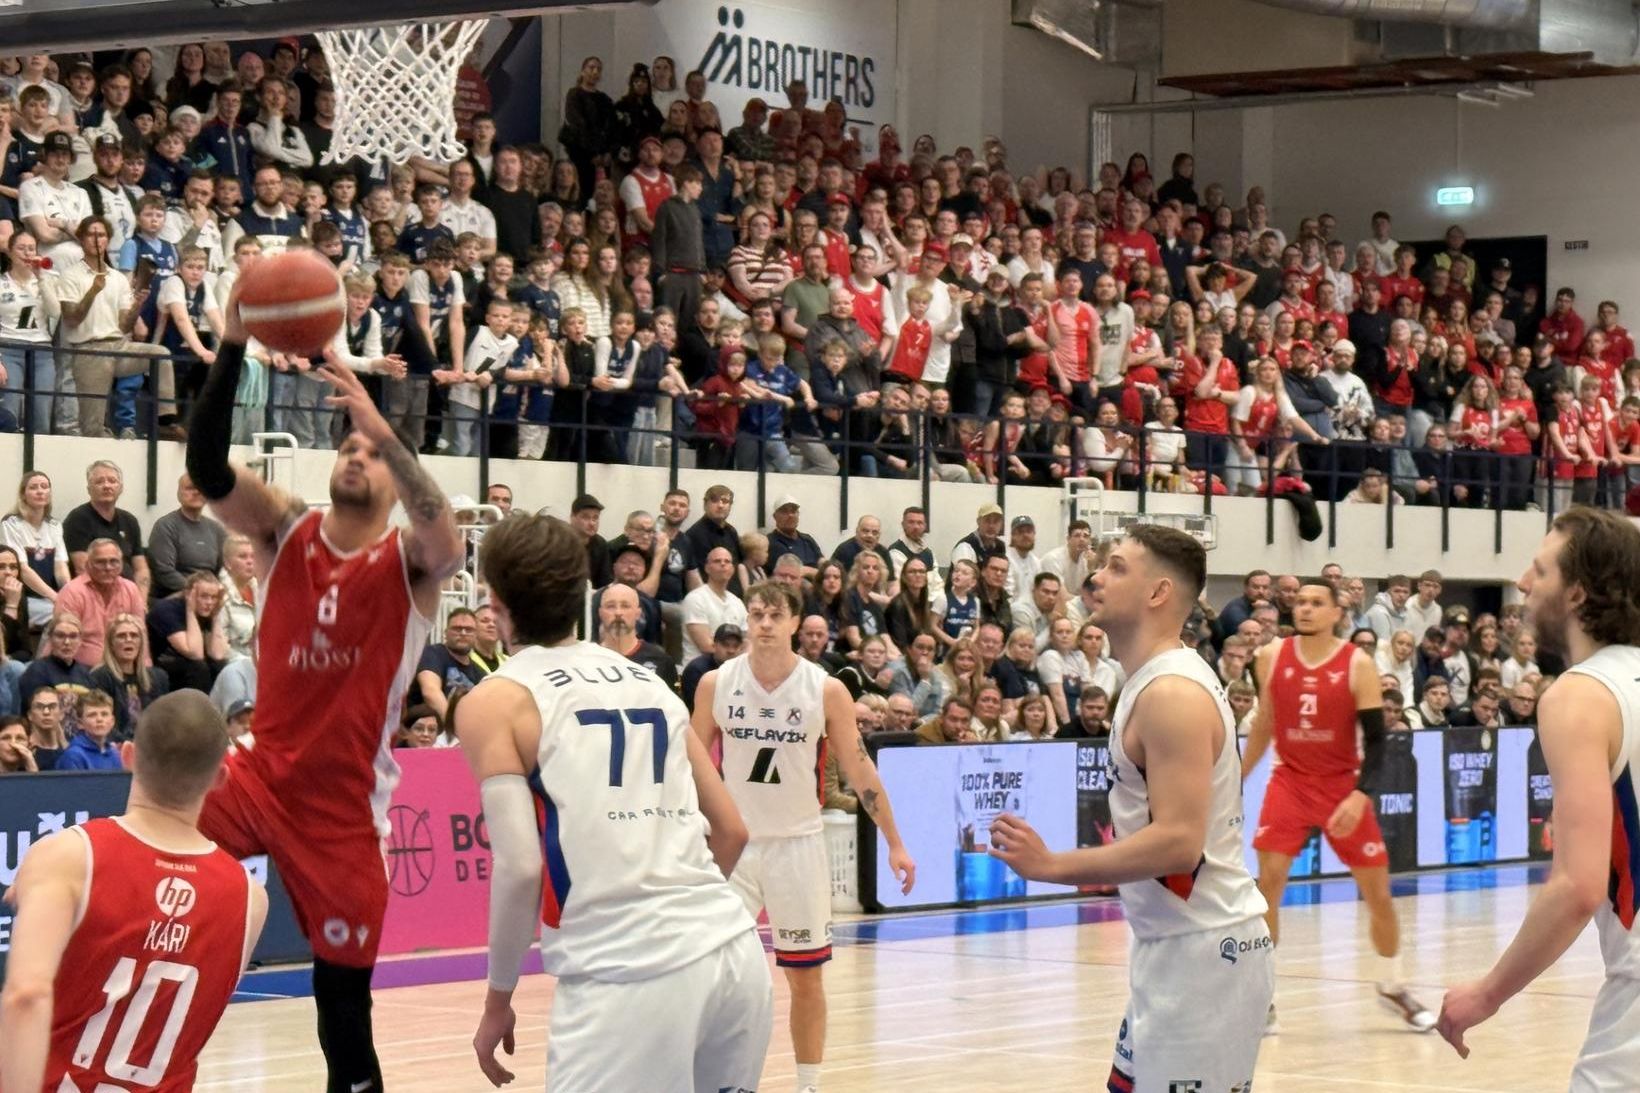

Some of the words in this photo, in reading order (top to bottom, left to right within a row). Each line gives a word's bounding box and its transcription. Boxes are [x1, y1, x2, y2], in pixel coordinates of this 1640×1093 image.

[747, 36, 876, 109] BROTHERS
[544, 665, 652, 688] BLUE
[727, 705, 746, 720] 14
[574, 707, 669, 788] 77
[991, 771, 1023, 790] PURE
[974, 790, 1010, 810] WHEY
[160, 877, 193, 917] hp
[71, 956, 199, 1087] 10
